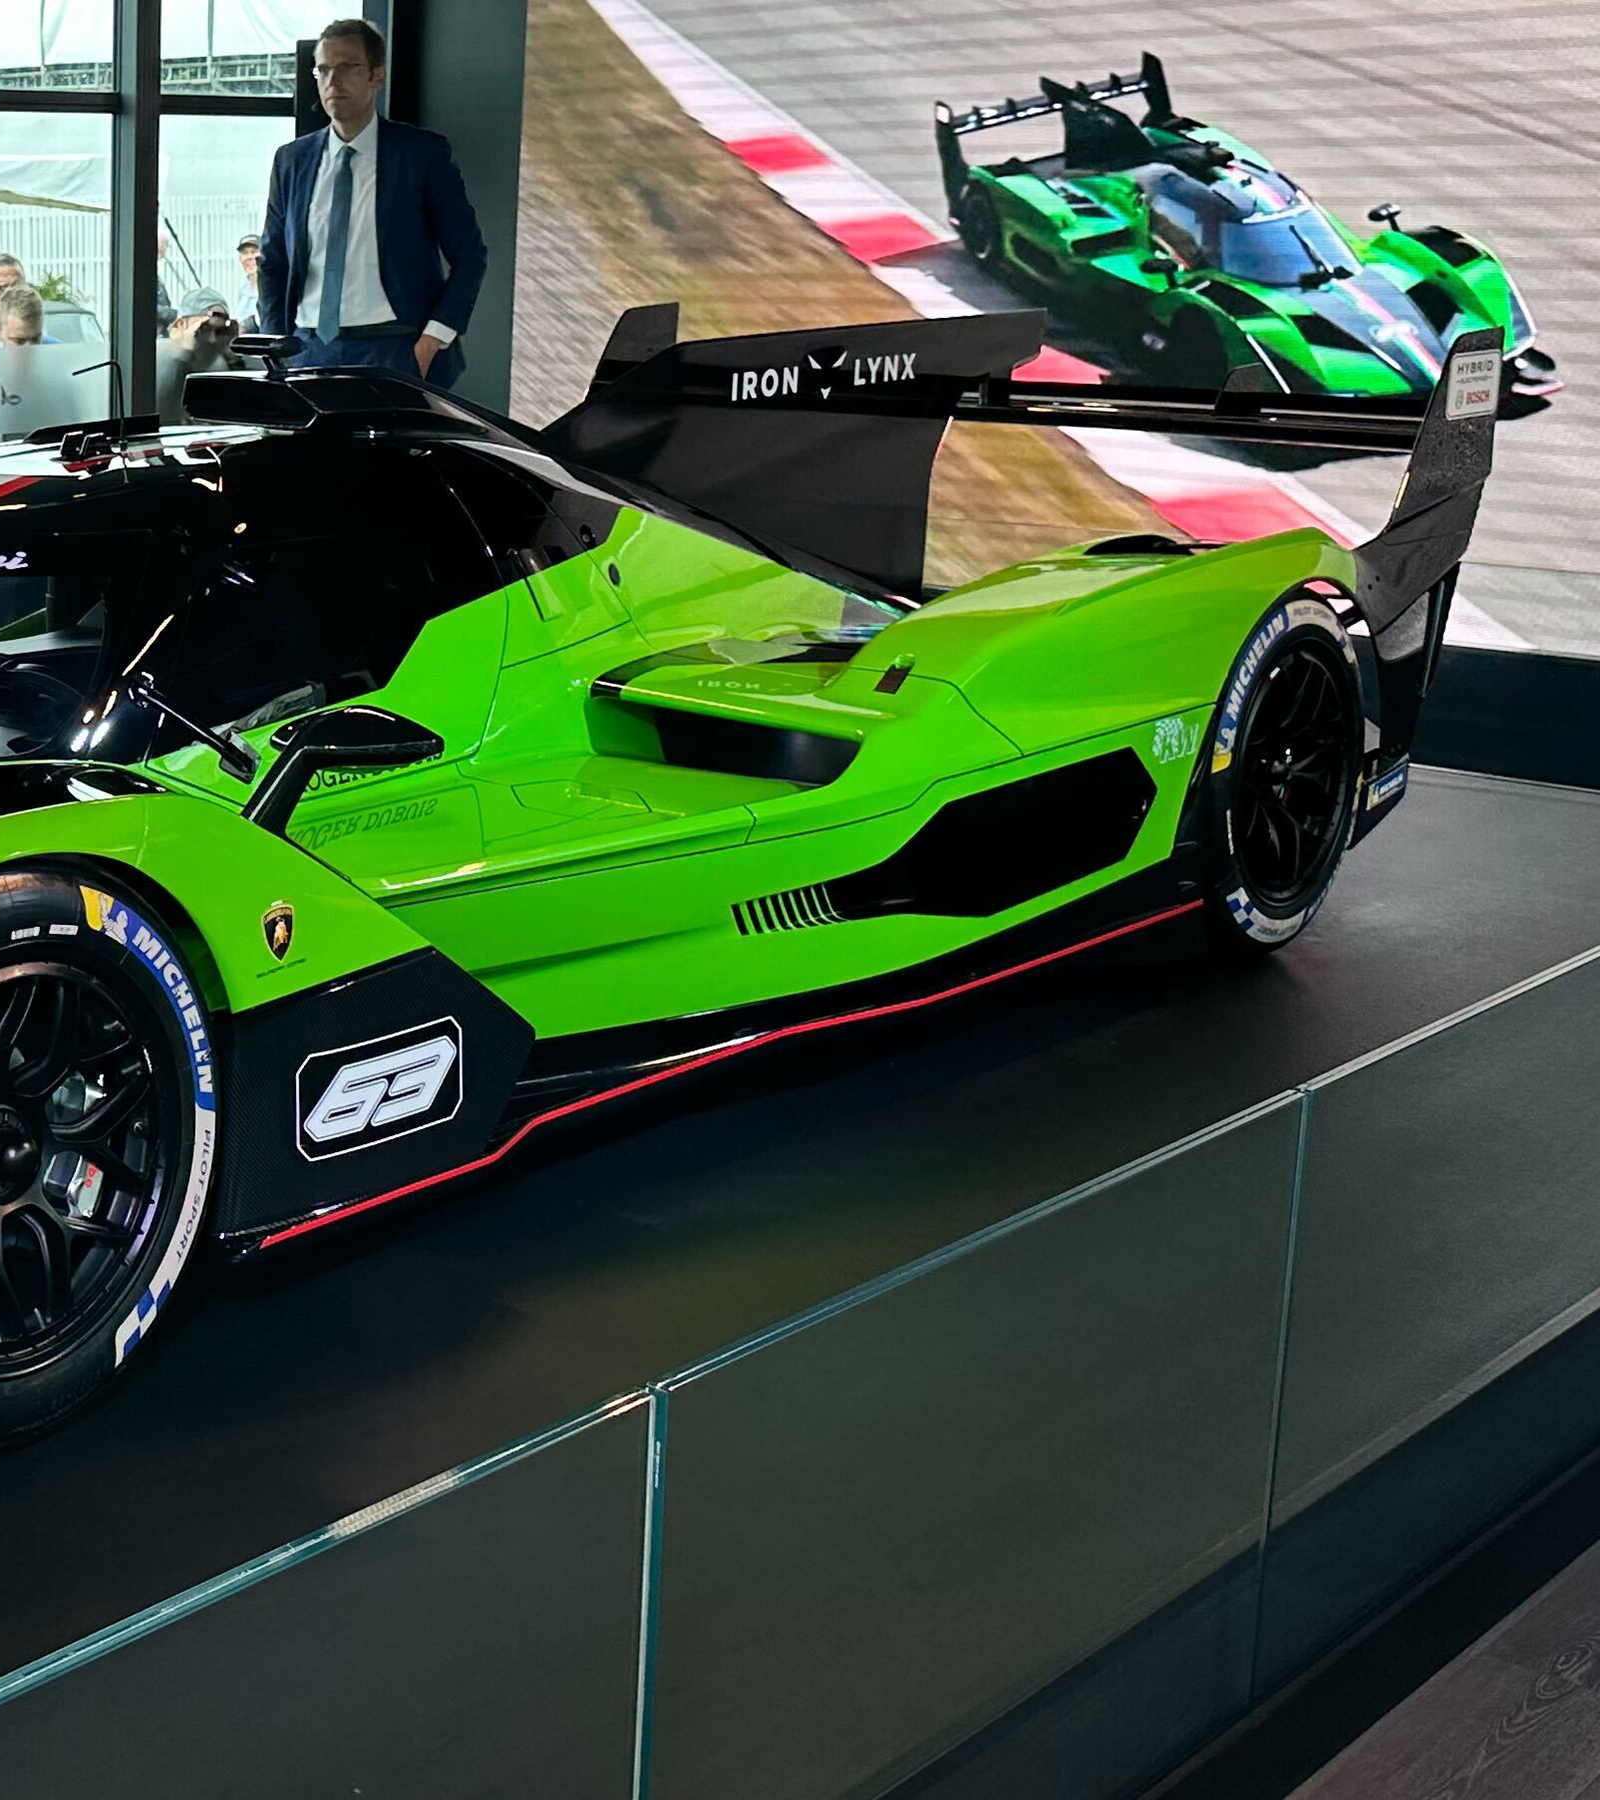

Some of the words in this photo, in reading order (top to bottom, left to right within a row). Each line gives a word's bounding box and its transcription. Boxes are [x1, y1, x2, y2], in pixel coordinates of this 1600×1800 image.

[731, 366, 799, 402] IRON
[853, 352, 917, 386] LYNX
[1457, 360, 1494, 375] HYBRID
[1225, 612, 1286, 723] MICHELIN
[132, 926, 213, 1093] MICHELIN
[303, 1035, 457, 1143] 63
[198, 1129, 212, 1187] PILOT
[175, 1193, 202, 1265] SPORT
